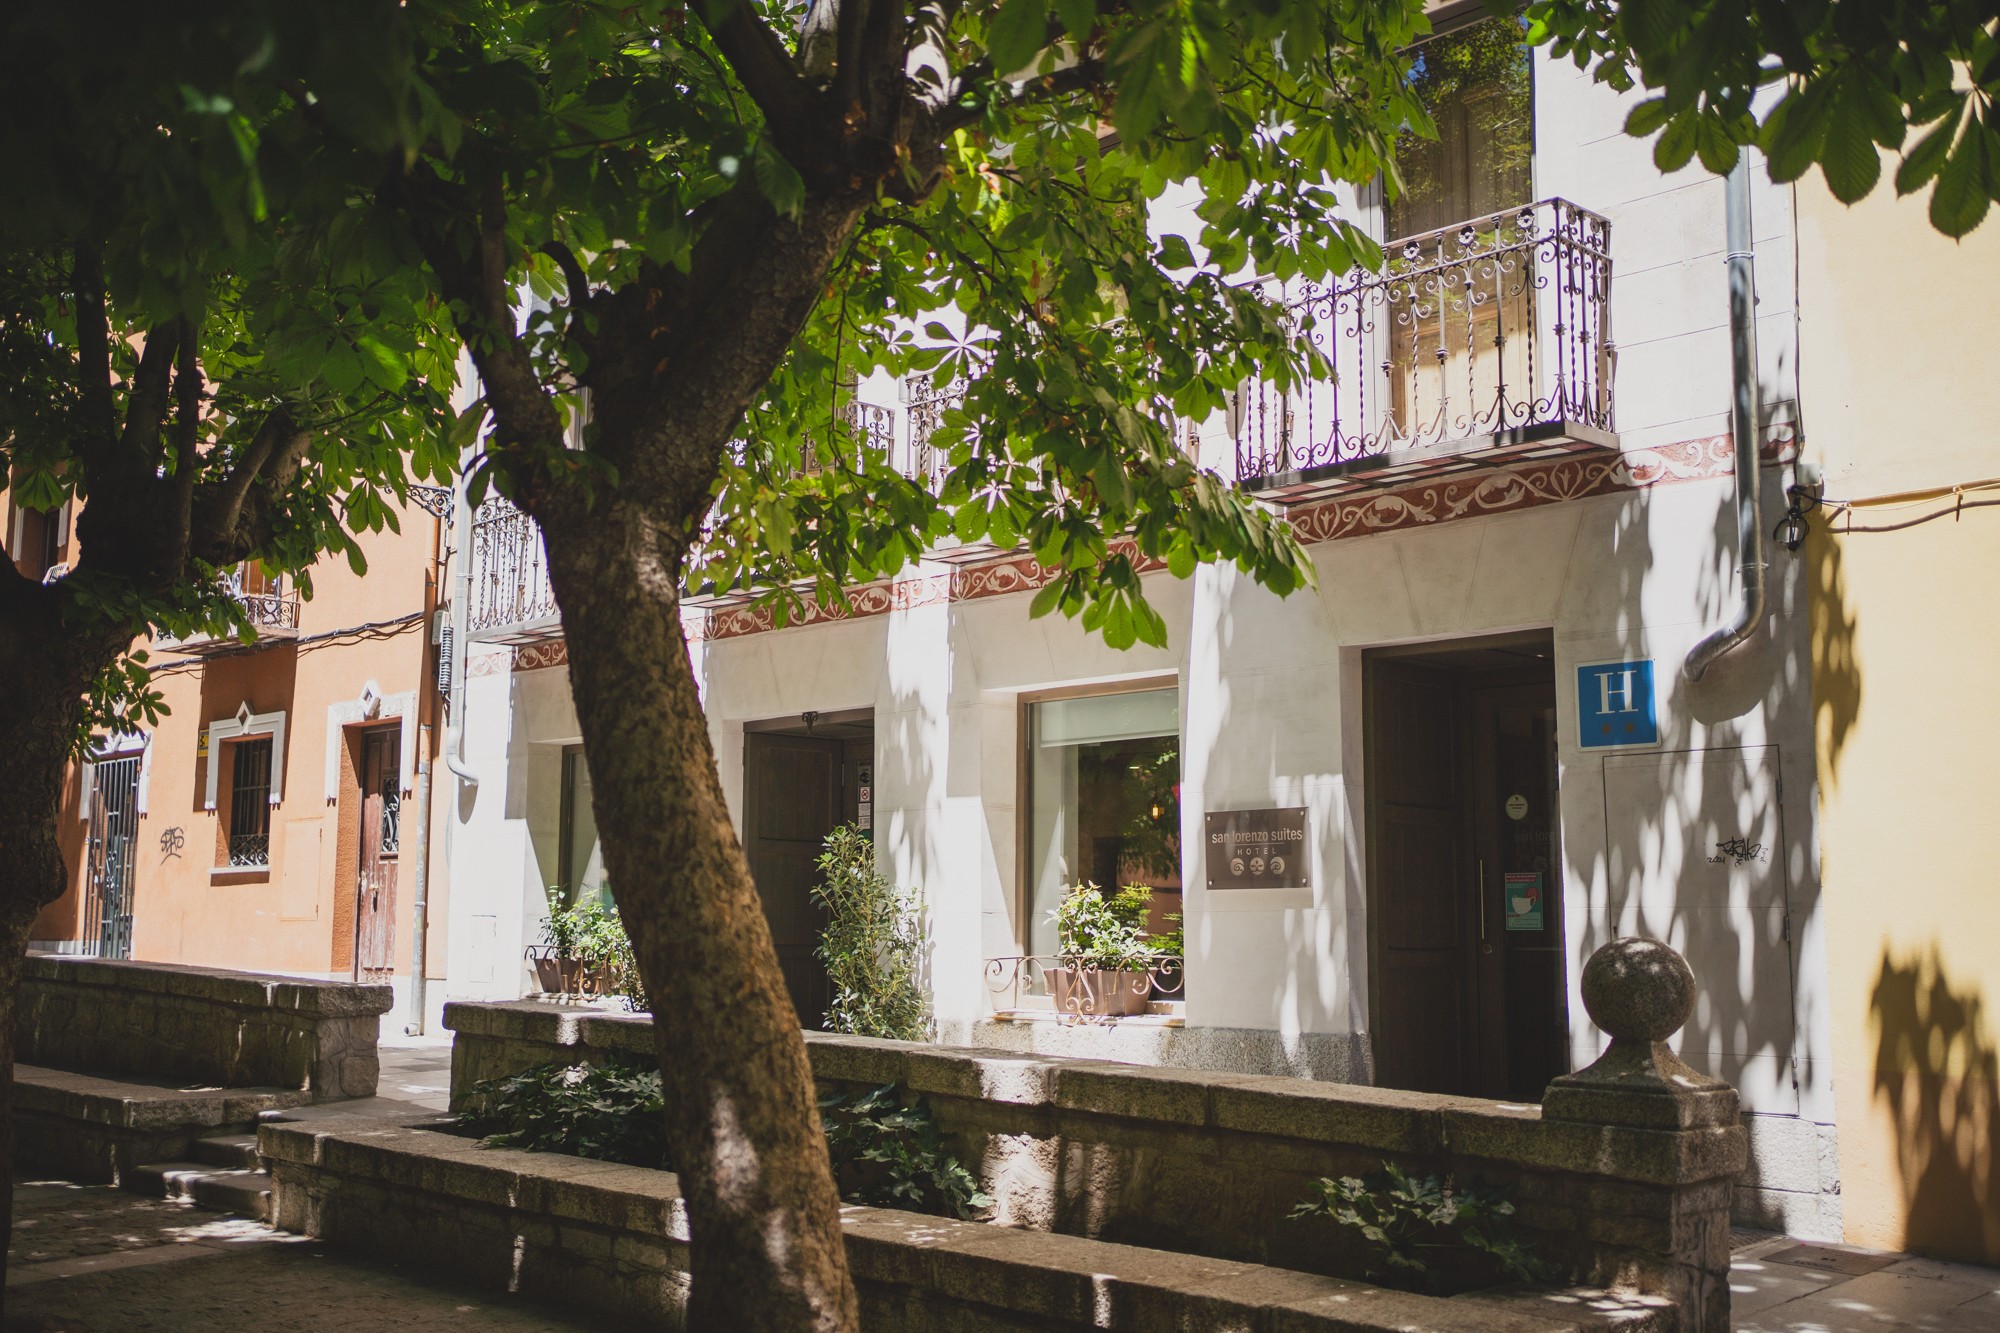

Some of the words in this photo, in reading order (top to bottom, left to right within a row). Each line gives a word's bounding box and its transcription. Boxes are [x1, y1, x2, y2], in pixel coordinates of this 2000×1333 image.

[1594, 670, 1638, 714] H
[1212, 832, 1230, 843] san
[1232, 830, 1268, 842] lorenzo
[1271, 828, 1302, 840] suites
[1237, 847, 1277, 856] HOTEL
